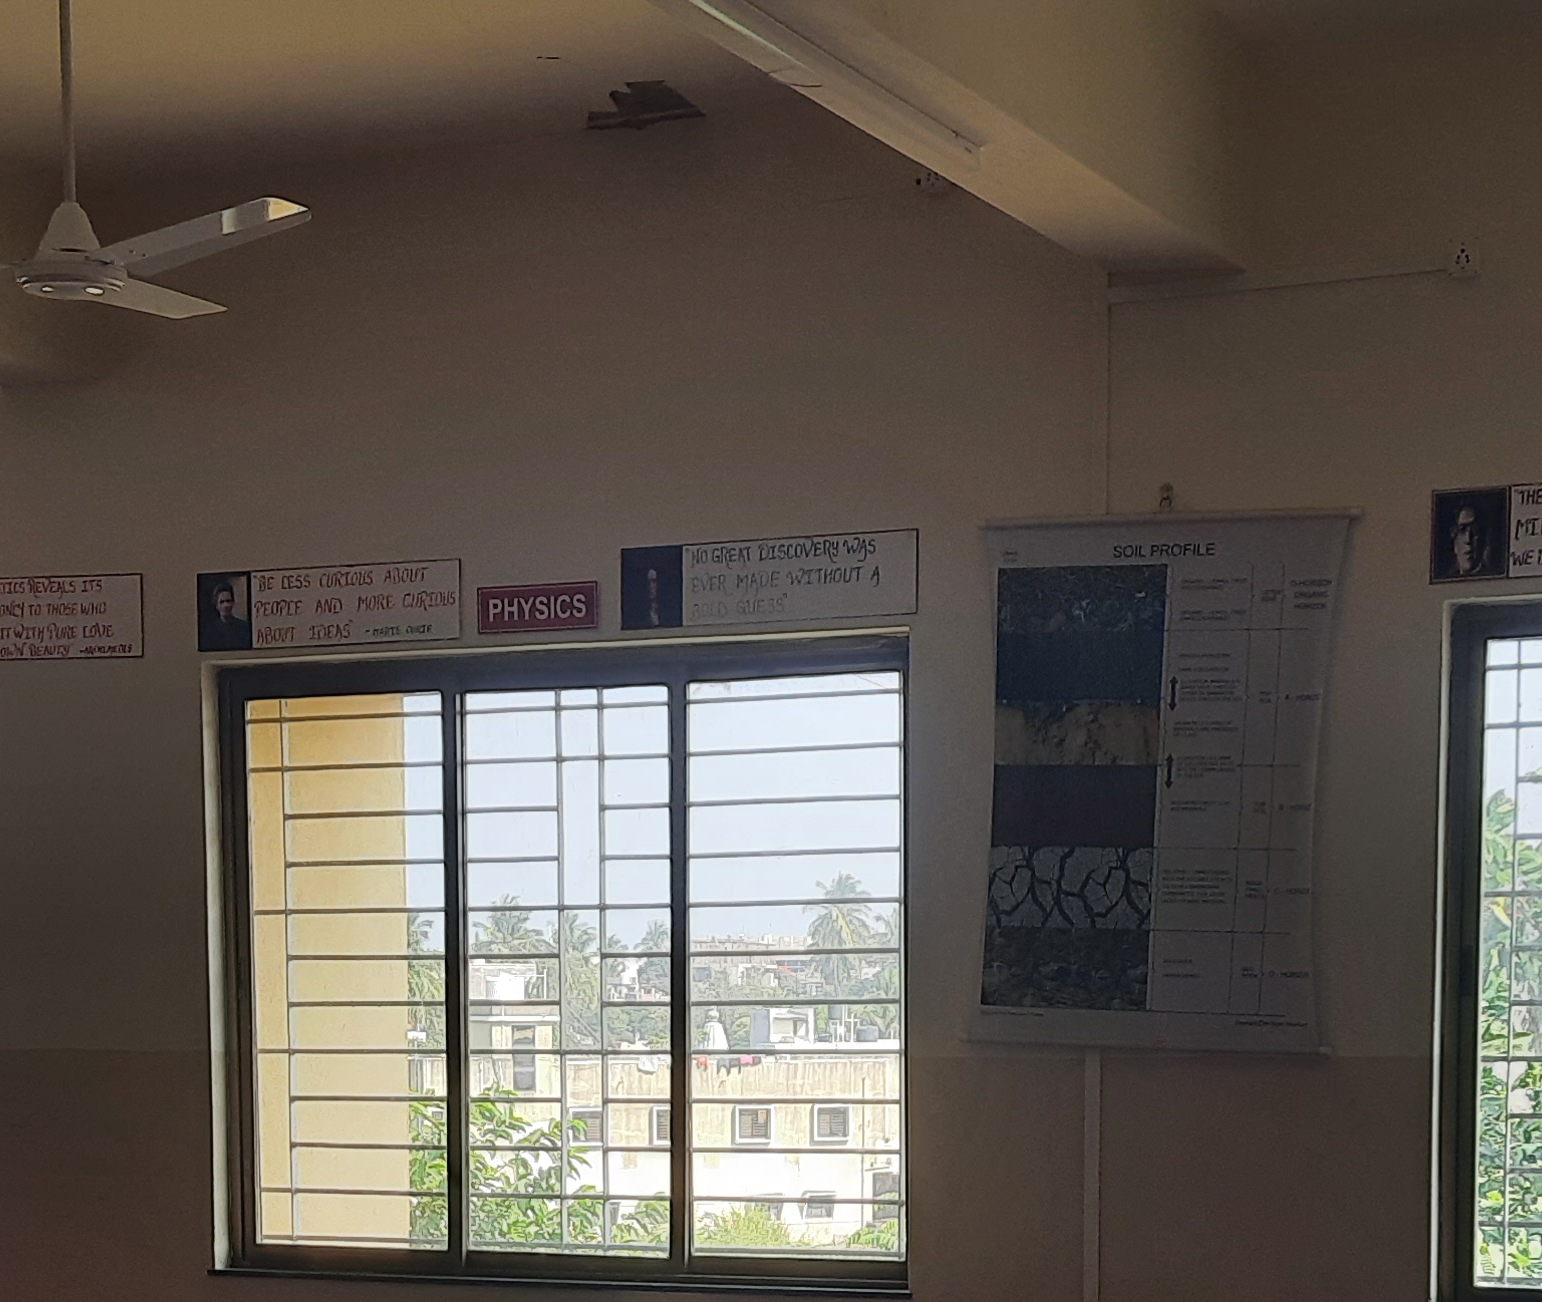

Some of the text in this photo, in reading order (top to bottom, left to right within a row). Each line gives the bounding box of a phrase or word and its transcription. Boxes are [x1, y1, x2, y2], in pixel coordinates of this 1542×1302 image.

[712, 546, 751, 569] GREAT
[758, 540, 839, 563] DISCOVERY
[843, 536, 876, 562] WAS
[1113, 542, 1215, 558] SOIL PROFILE
[1511, 549, 1534, 566] WE
[281, 576, 311, 590] LESS
[319, 570, 373, 588] CURIOUS
[384, 566, 429, 584] ABOUT
[691, 564, 881, 596] EVER MADE WITHOUT A
[27, 579, 76, 598] REVEALS
[81, 579, 103, 593] ITS
[0, 600, 25, 619] ONLY
[29, 603, 41, 616] TO
[47, 602, 79, 616] THOSE
[81, 601, 107, 616] WHO
[254, 590, 456, 618] PEOPLE AND MORE CURIOUS
[489, 593, 587, 622] PHYSICS
[0, 626, 13, 640] IT
[13, 623, 45, 643] WITH
[47, 622, 77, 640] PURE
[83, 623, 115, 639] LOVE
[257, 626, 297, 646] ABOUT
[0, 644, 25, 658] OWN
